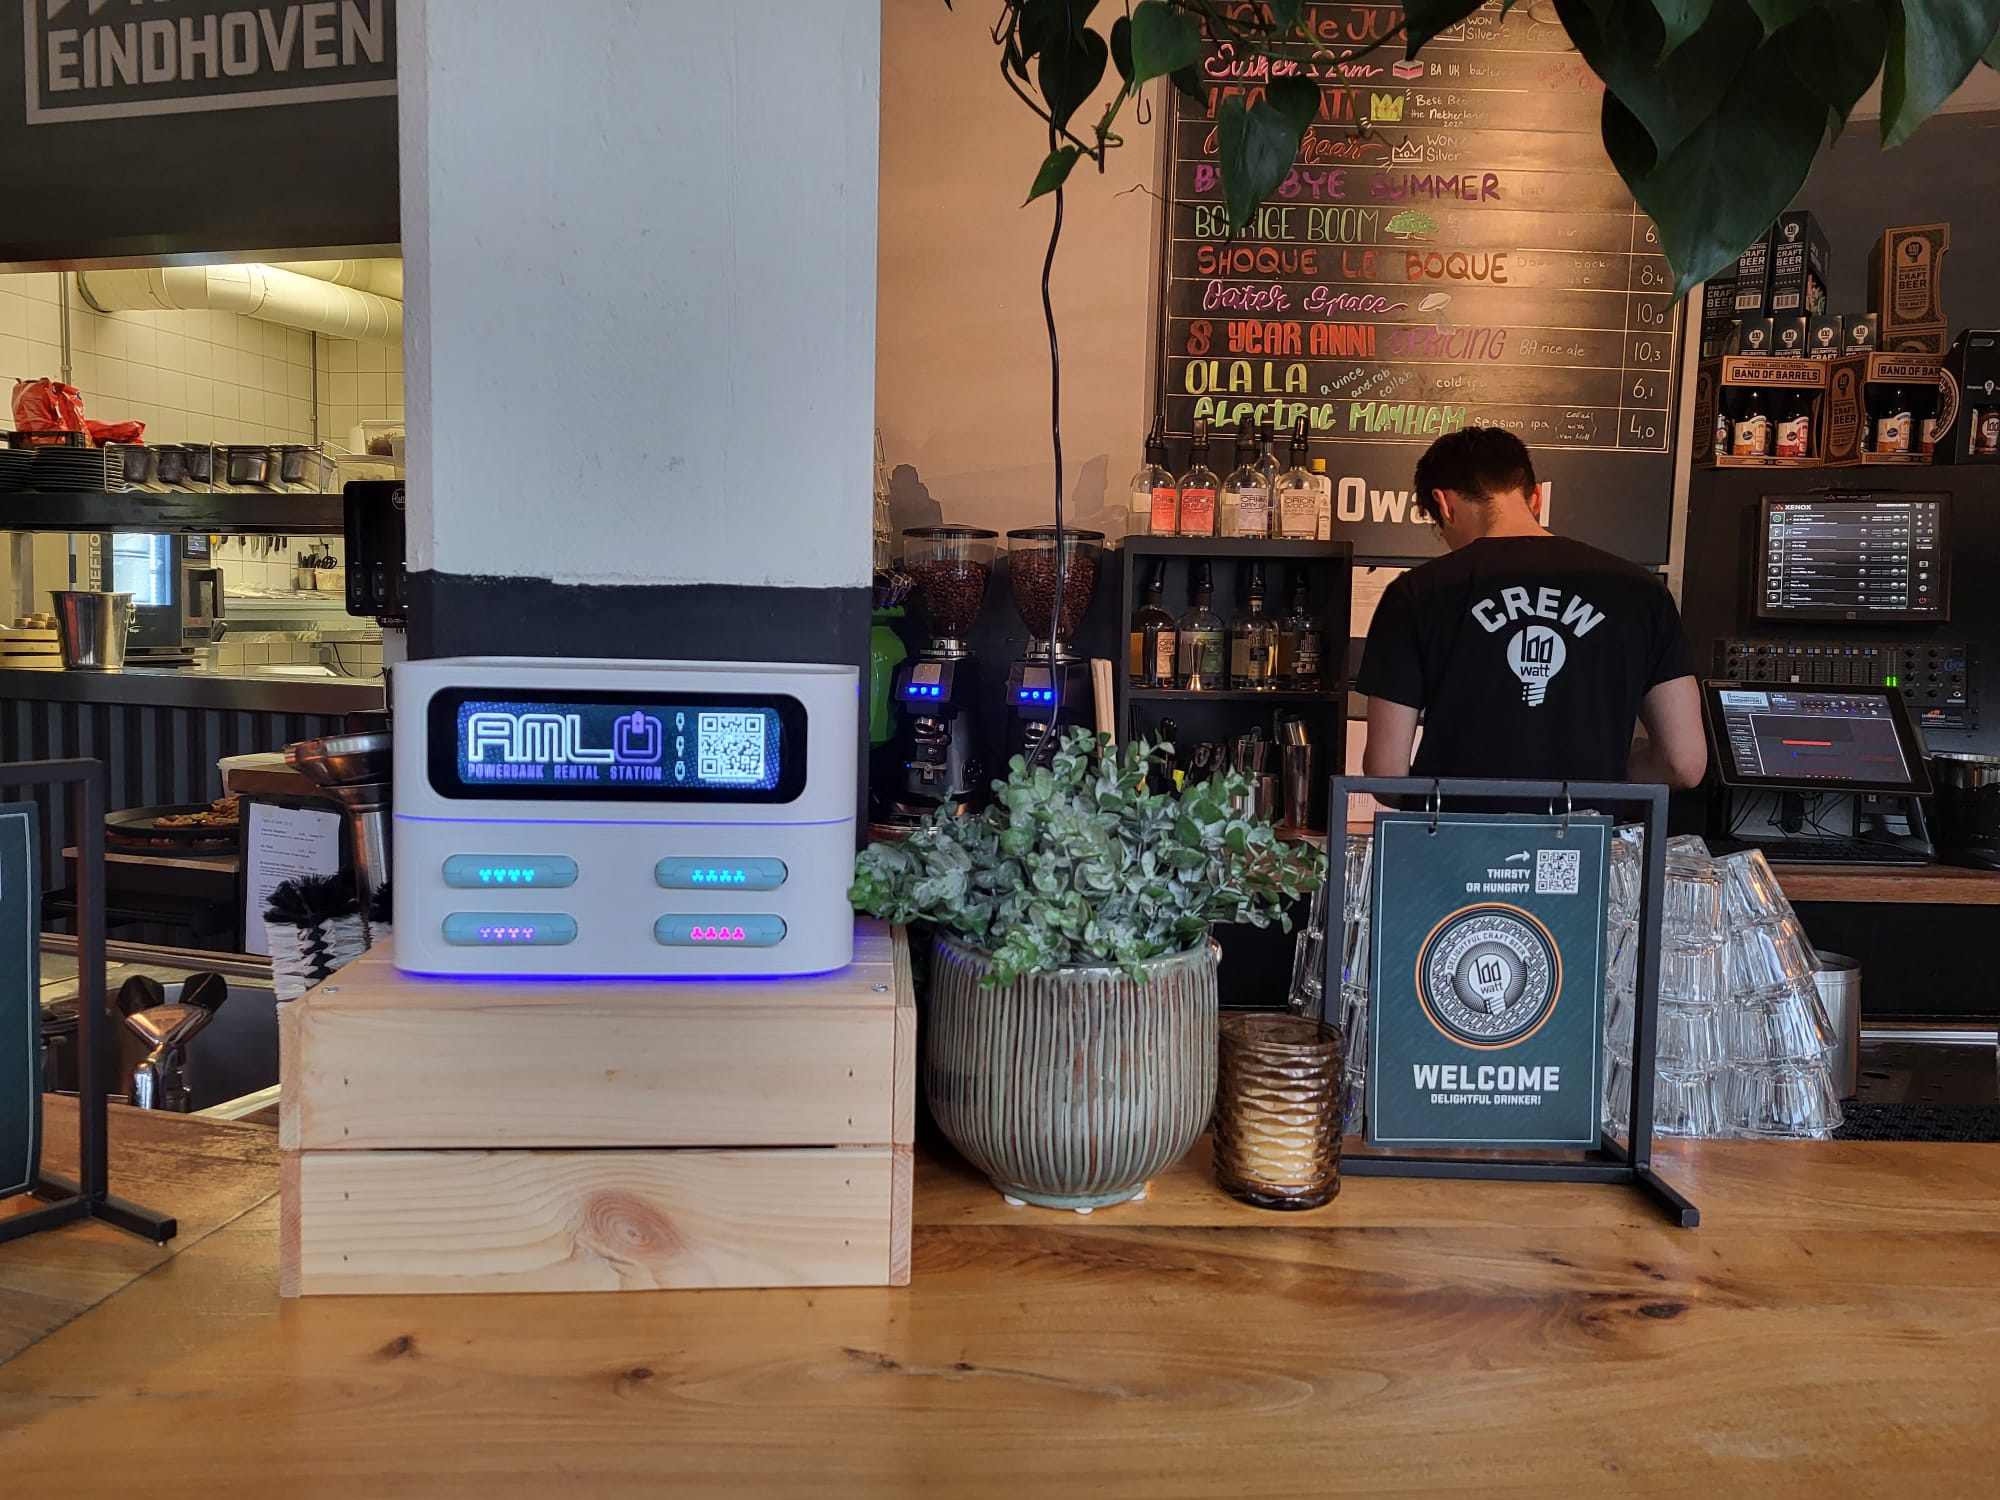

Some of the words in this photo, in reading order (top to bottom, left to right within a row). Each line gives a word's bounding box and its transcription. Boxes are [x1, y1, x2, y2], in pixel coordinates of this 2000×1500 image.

[1467, 17, 1493, 25] WON
[1466, 27, 1501, 40] Silver
[47, 0, 384, 92] EINDHOVEN
[1430, 64, 1442, 76] BA
[1416, 95, 1443, 107] Best
[1427, 135, 1457, 147] WON
[1426, 148, 1462, 162] Silver
[1371, 172, 1501, 202] SUMMER
[1307, 208, 1379, 243] BOOM
[1777, 249, 1803, 258] CRAFT
[1198, 246, 1319, 275] SHOQUE
[1342, 250, 1378, 278] LE
[1405, 252, 1508, 284] BOQUE
[1740, 257, 1766, 267] BEER
[1776, 257, 1802, 267] BEER
[1899, 272, 1927, 281] CRAFT
[1898, 279, 1927, 290] BEER
[1708, 289, 1734, 299] CRAF
[1187, 320, 1213, 354] 8
[1310, 323, 1376, 356] ANNI
[1519, 339, 1537, 355] BA
[1541, 343, 1563, 355] rice
[1566, 344, 1585, 357] ale
[1734, 369, 1760, 378] BAND
[1762, 370, 1774, 379] OF
[1775, 371, 1818, 380] BARRELS
[1880, 366, 1906, 375] BAND
[1909, 367, 1920, 375] OF
[1185, 360, 1252, 394] OLA
[1264, 361, 1307, 393] LA
[1436, 377, 1462, 389] cold
[1833, 415, 1856, 424] BEER
[1471, 586, 1606, 638] CREW
[1521, 625, 1553, 664] 100
[1520, 663, 1551, 678] watt
[468, 764, 544, 779] POWERBANK
[554, 765, 600, 780] RENTAL
[610, 765, 662, 781] STATION
[1487, 869, 1531, 879] THIRSTY
[1466, 883, 1481, 893] OR
[1483, 883, 1530, 893] HUNGRY?
[1447, 935, 1481, 970] DELIGHTFUL
[1483, 932, 1509, 941] CRAFT
[1509, 939, 1526, 955] BEER
[1475, 959, 1502, 985] 100
[1480, 983, 1504, 995] watt
[1413, 1064, 1560, 1092] WELCOME
[1430, 1093, 1491, 1105] DELIGHTFUL
[1494, 1094, 1541, 1106] DRINKER!
